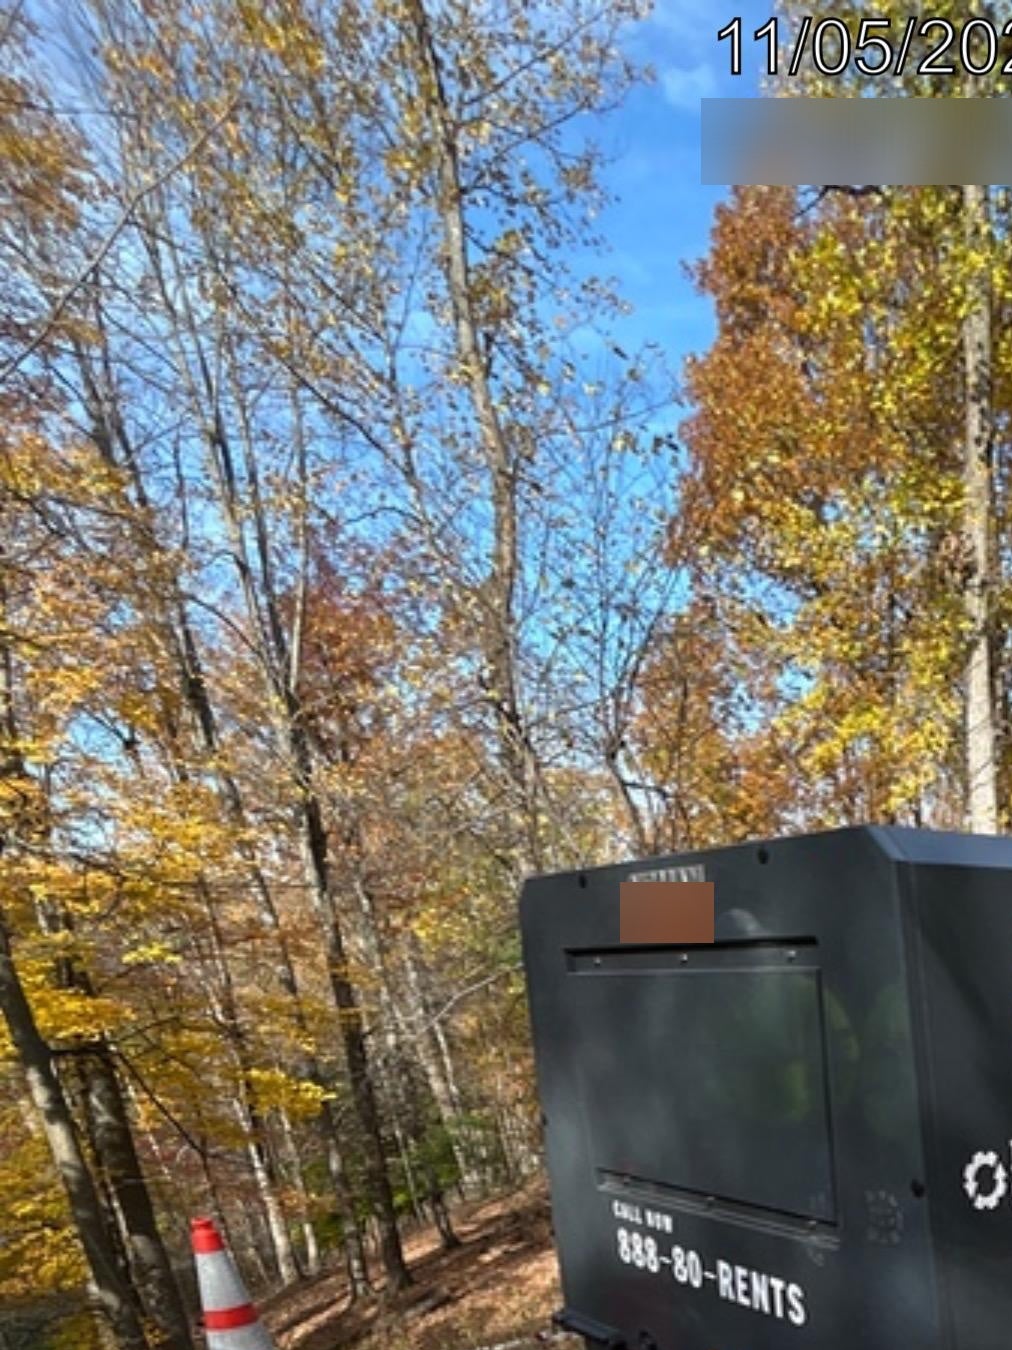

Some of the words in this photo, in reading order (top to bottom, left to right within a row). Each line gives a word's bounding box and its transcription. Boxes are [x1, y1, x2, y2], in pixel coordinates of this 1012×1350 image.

[612, 1199, 643, 1225] CALL
[644, 1208, 674, 1234] NOW
[616, 1226, 806, 1326] 888-80-RENTS
